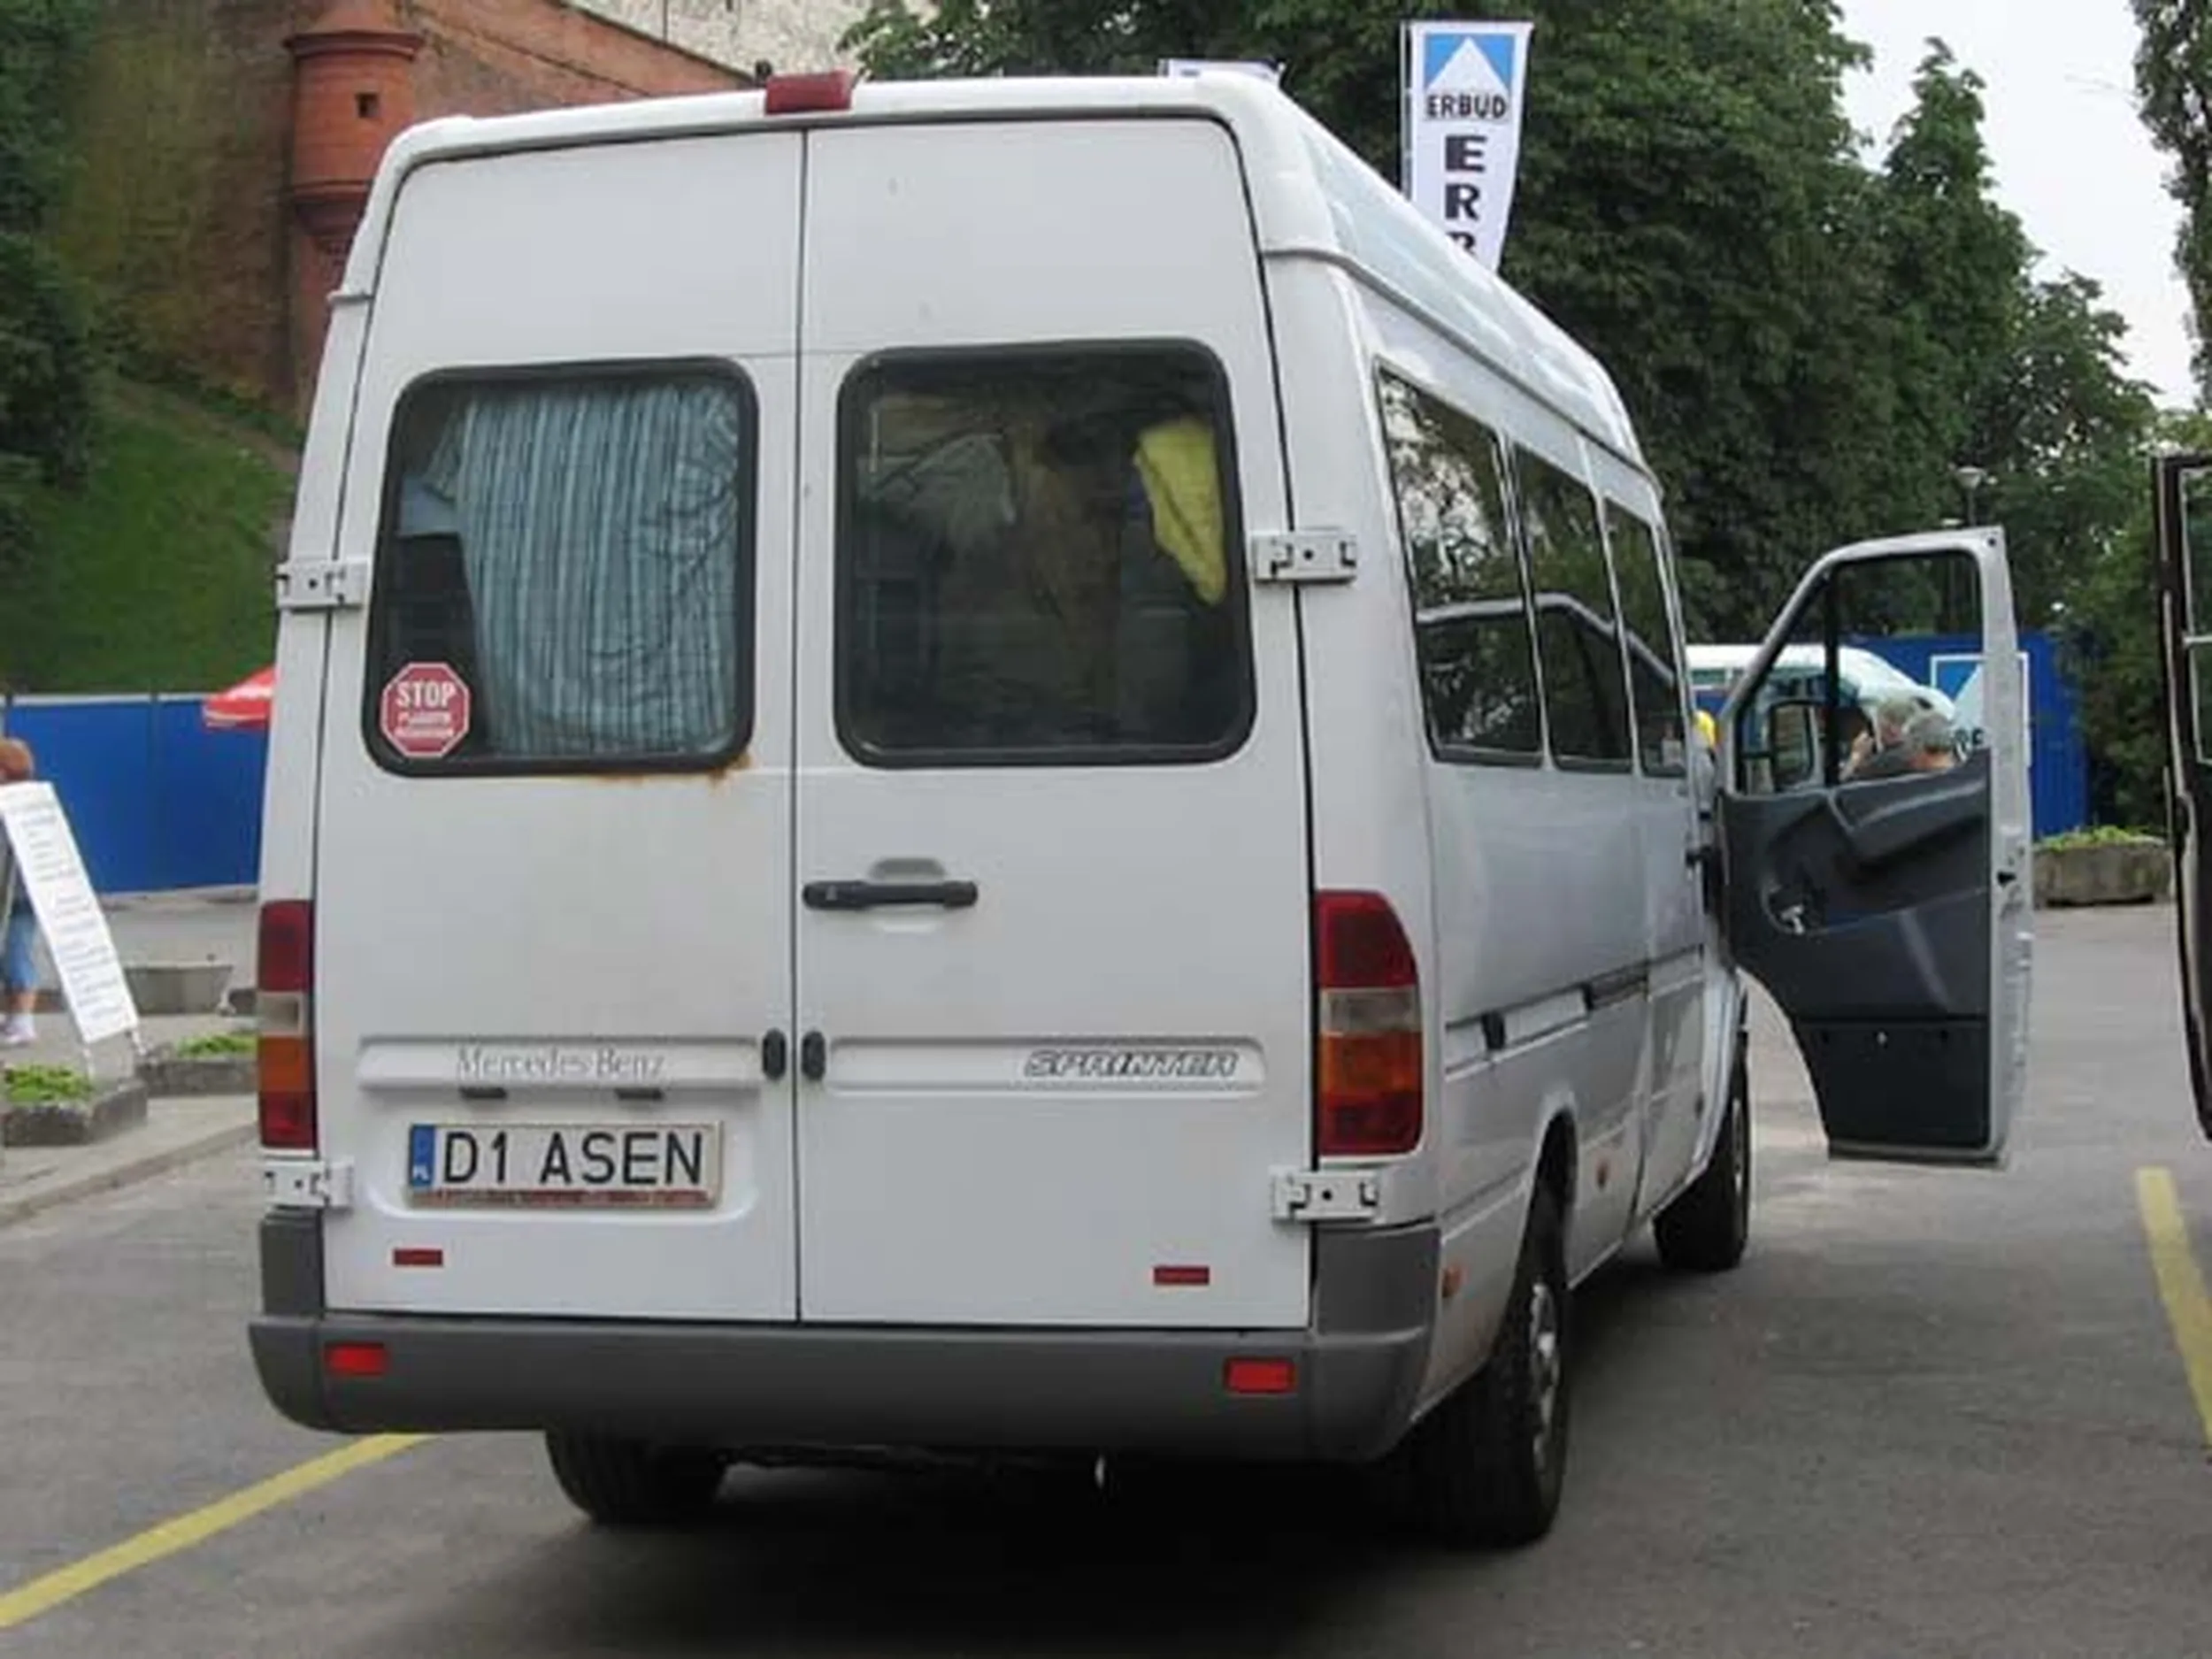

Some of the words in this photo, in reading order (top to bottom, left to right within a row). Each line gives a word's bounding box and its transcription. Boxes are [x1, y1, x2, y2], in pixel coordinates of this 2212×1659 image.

[1425, 94, 1508, 119] ERBUD
[396, 679, 457, 708] STOP
[1023, 1048, 1240, 1079] SPRINTER
[444, 1130, 508, 1185] D1
[539, 1131, 703, 1186] ASEN
